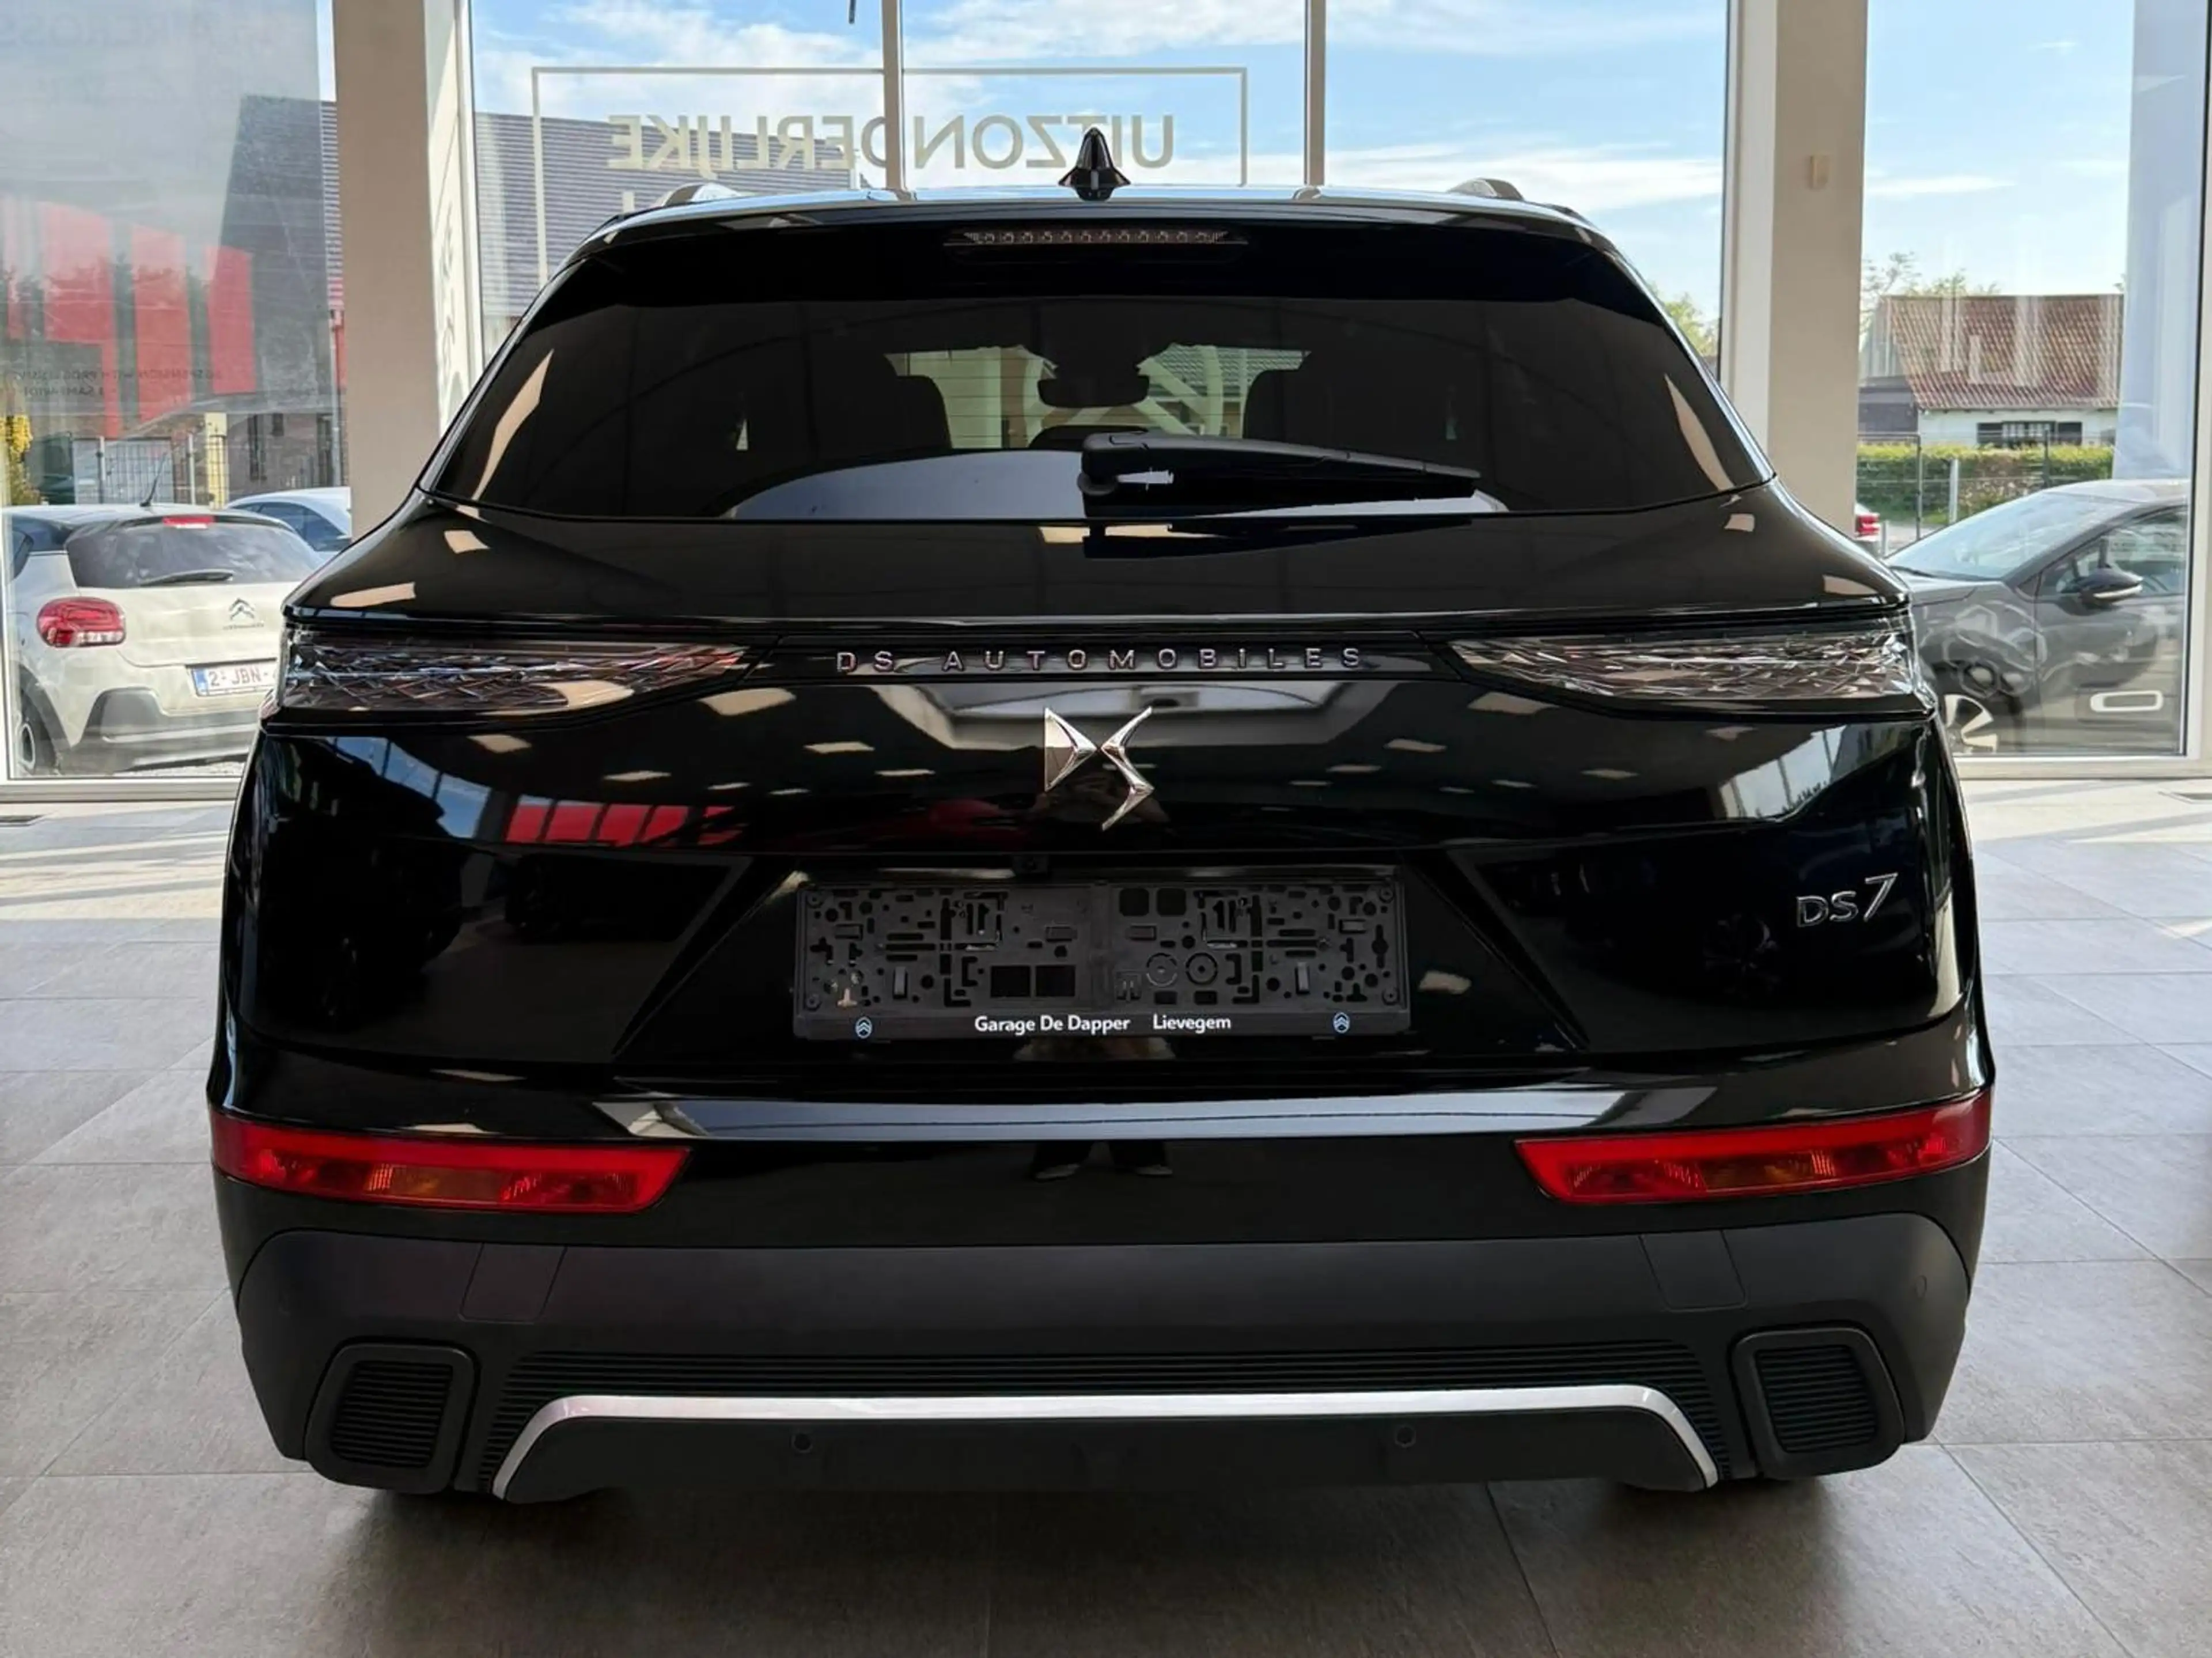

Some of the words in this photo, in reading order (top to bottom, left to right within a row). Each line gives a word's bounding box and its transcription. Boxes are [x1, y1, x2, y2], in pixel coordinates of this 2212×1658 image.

[836, 651, 893, 672] DS
[942, 648, 1359, 671] AUTOMOBILES
[974, 1015, 1036, 1035] Garage
[1040, 1015, 1063, 1031] De
[1067, 1015, 1131, 1035] Dapper
[1153, 1013, 1232, 1034] Lievegem
